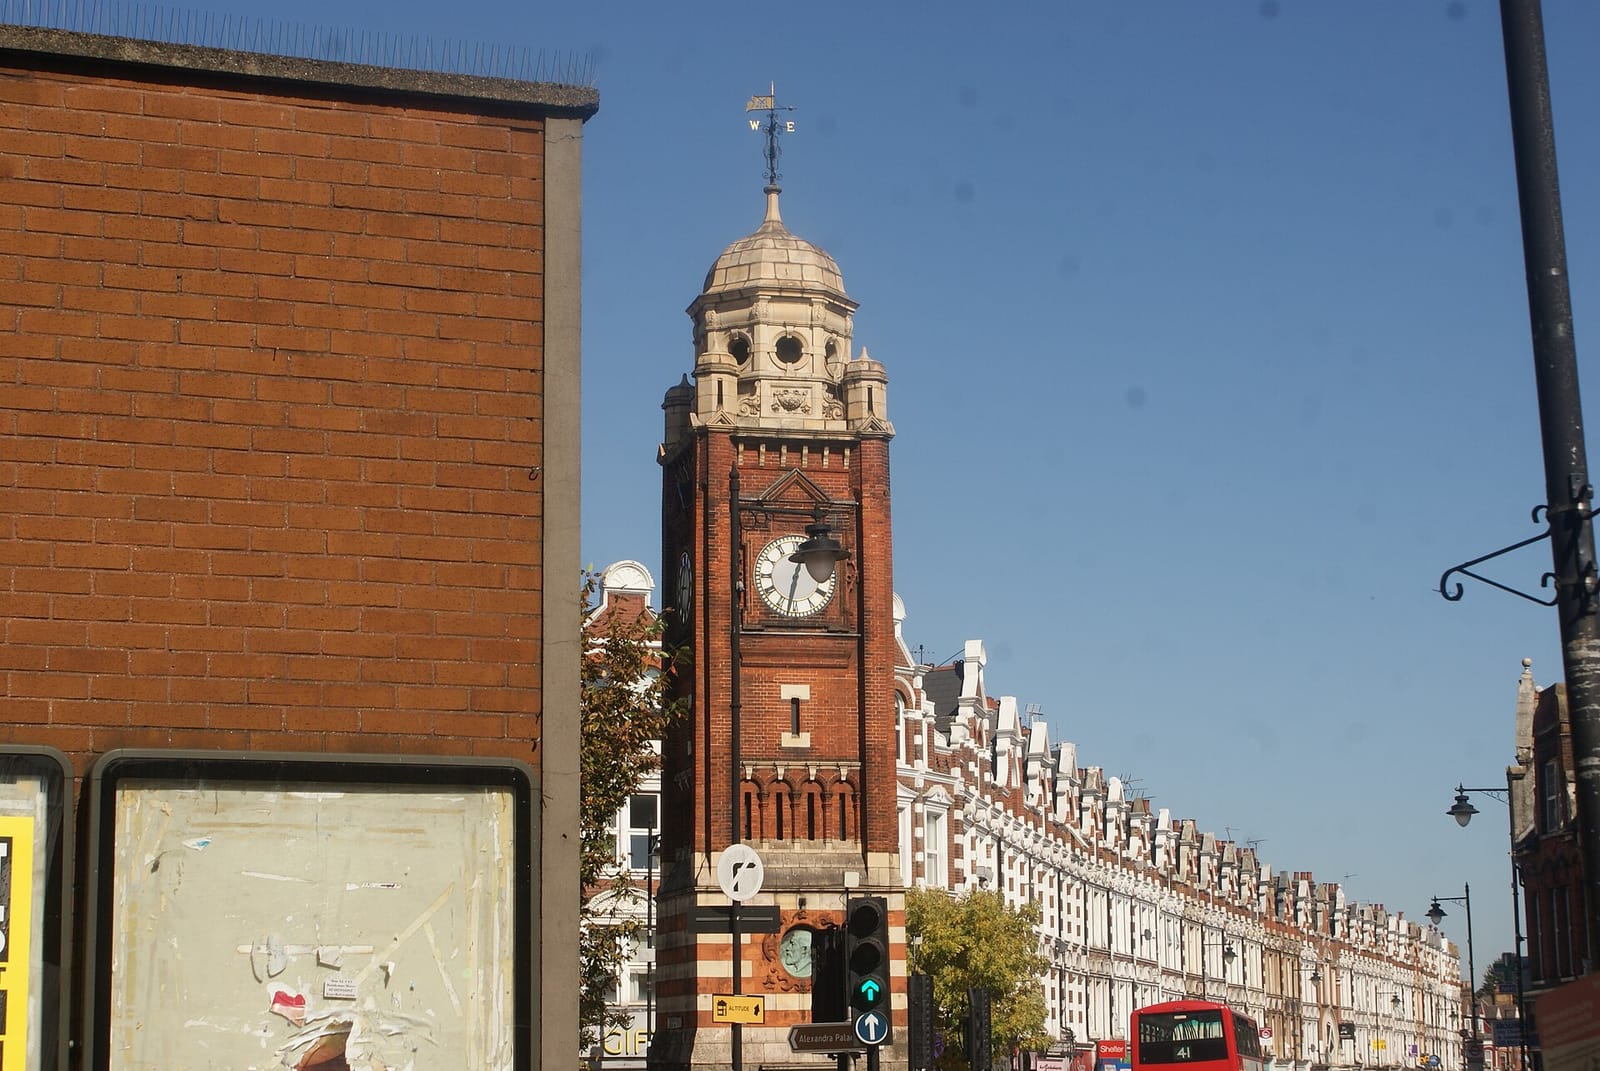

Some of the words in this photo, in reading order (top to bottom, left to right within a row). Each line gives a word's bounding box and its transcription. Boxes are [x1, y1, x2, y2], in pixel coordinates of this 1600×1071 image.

[749, 120, 760, 131] W
[786, 121, 795, 132] E
[799, 1034, 834, 1043] Alexandra
[1100, 1045, 1124, 1053] Shelter
[1176, 1046, 1190, 1058] 41
